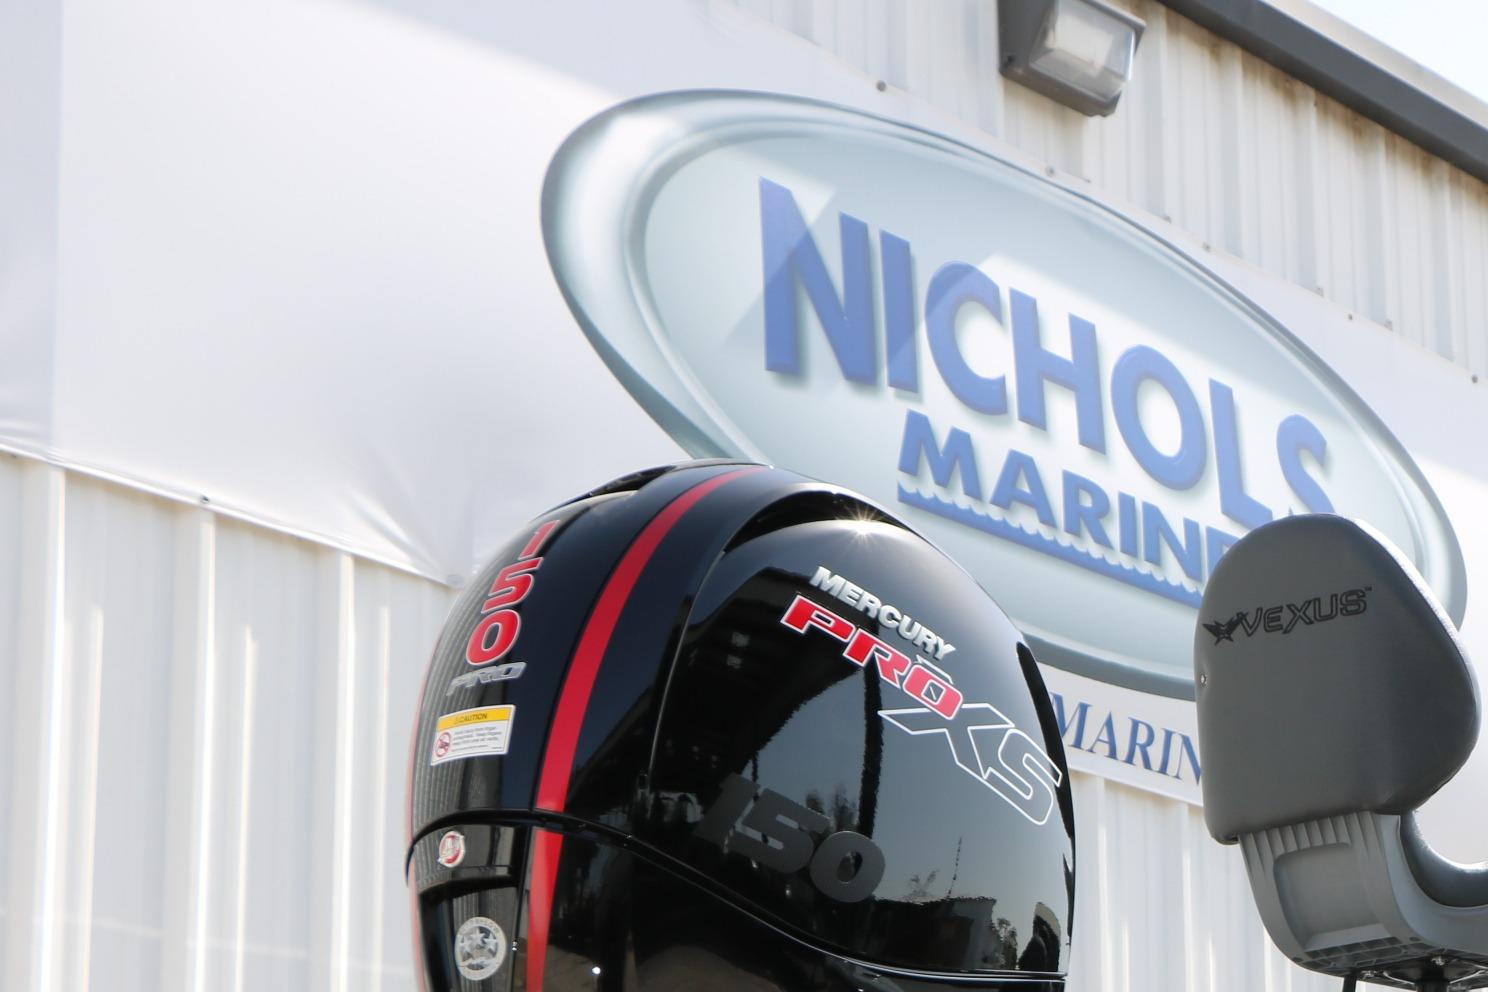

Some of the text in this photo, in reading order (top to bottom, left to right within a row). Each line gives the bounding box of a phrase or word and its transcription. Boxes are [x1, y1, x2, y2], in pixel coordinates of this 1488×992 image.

[758, 176, 1337, 529] NICHOLS
[465, 520, 560, 666] 150
[809, 566, 956, 660] MERCURY
[780, 594, 1063, 826] PRO XS
[694, 772, 886, 903] 150
